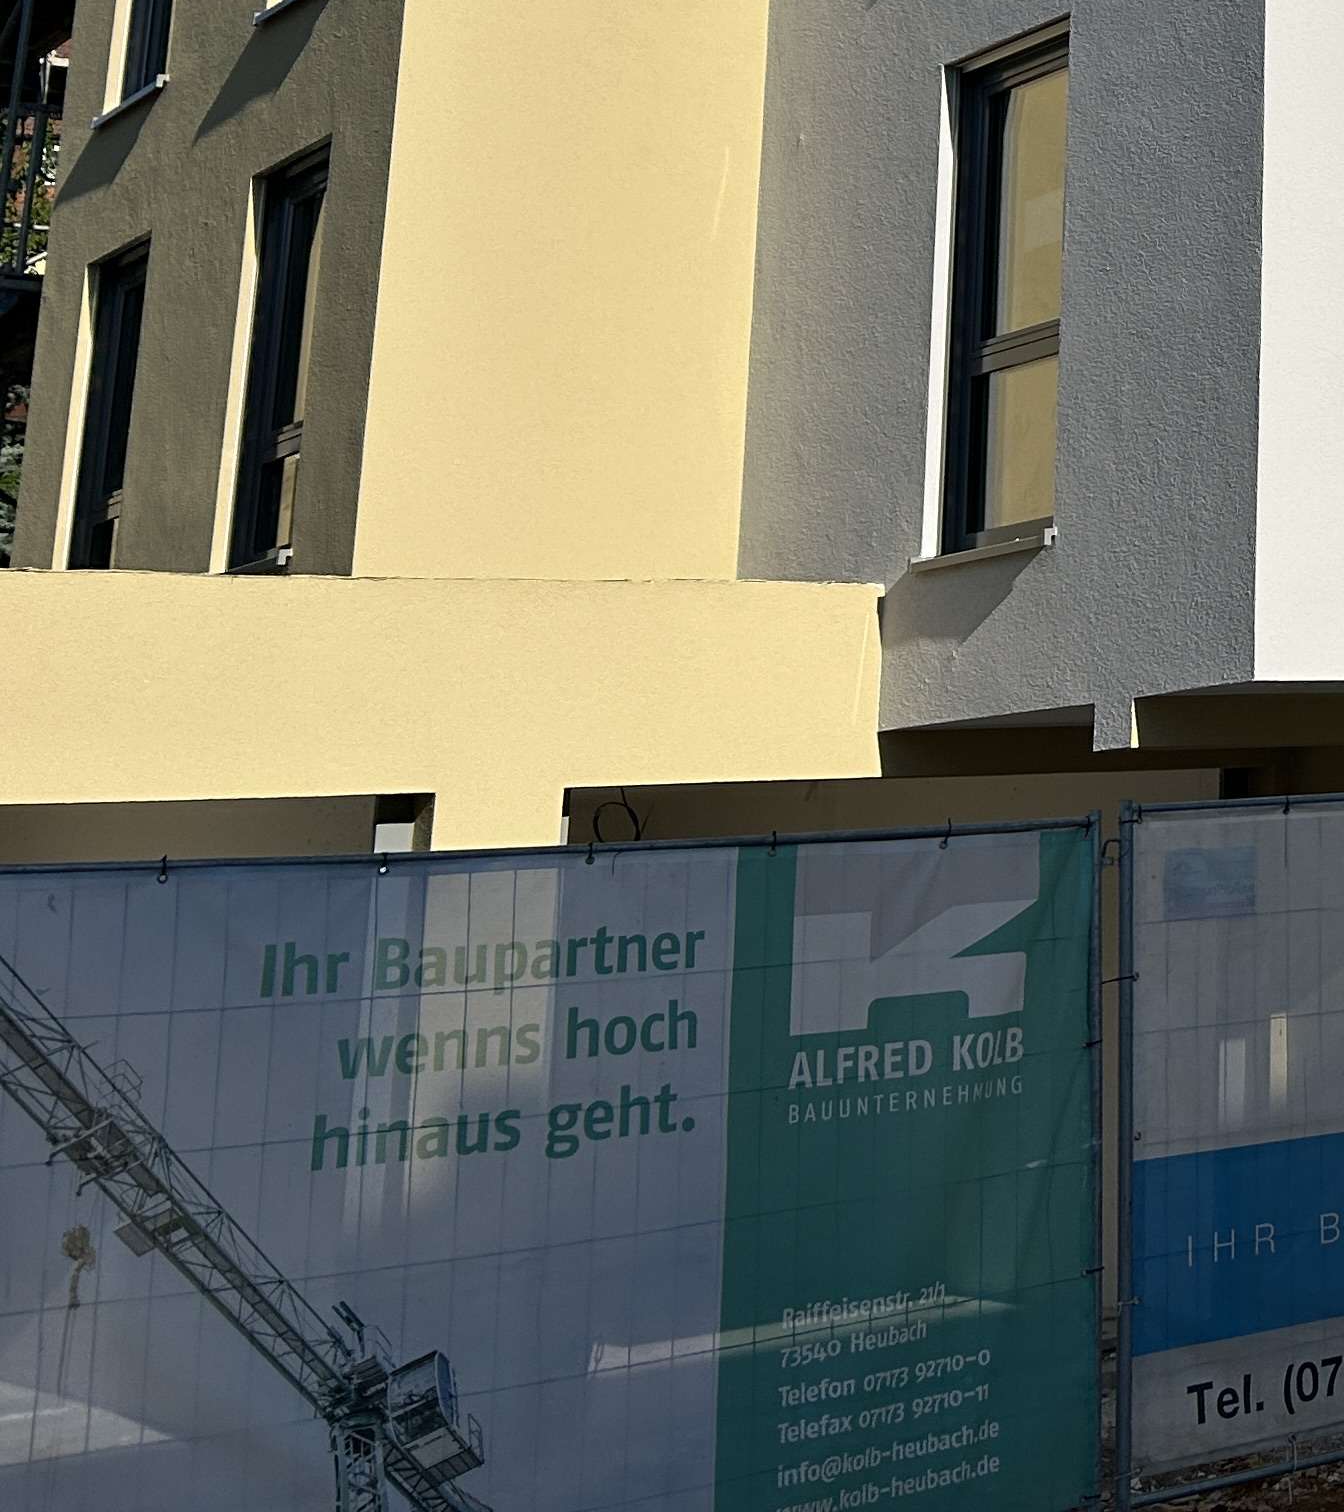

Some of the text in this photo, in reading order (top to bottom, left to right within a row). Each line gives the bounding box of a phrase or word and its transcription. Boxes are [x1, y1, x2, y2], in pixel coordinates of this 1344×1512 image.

[259, 926, 705, 998] Ihr Baupartner
[337, 999, 698, 1080] wenns hoch
[788, 1027, 1025, 1090] ALFRED KOLB
[311, 1083, 696, 1171] hinaus geht.
[1186, 1223, 1276, 1267] IHR
[782, 1291, 913, 1329] Raiffeisenstr.
[780, 1319, 928, 1368] 73540 Heubach
[778, 1349, 991, 1408] Telefon 07173 92710-0
[1187, 1374, 1265, 1425] Tel.
[776, 1383, 989, 1444] Telefax 07173 92710-11
[776, 1418, 1000, 1488] info@kolb-heubach.de
[776, 1454, 1001, 1512] ww.kolb-heubach.de
